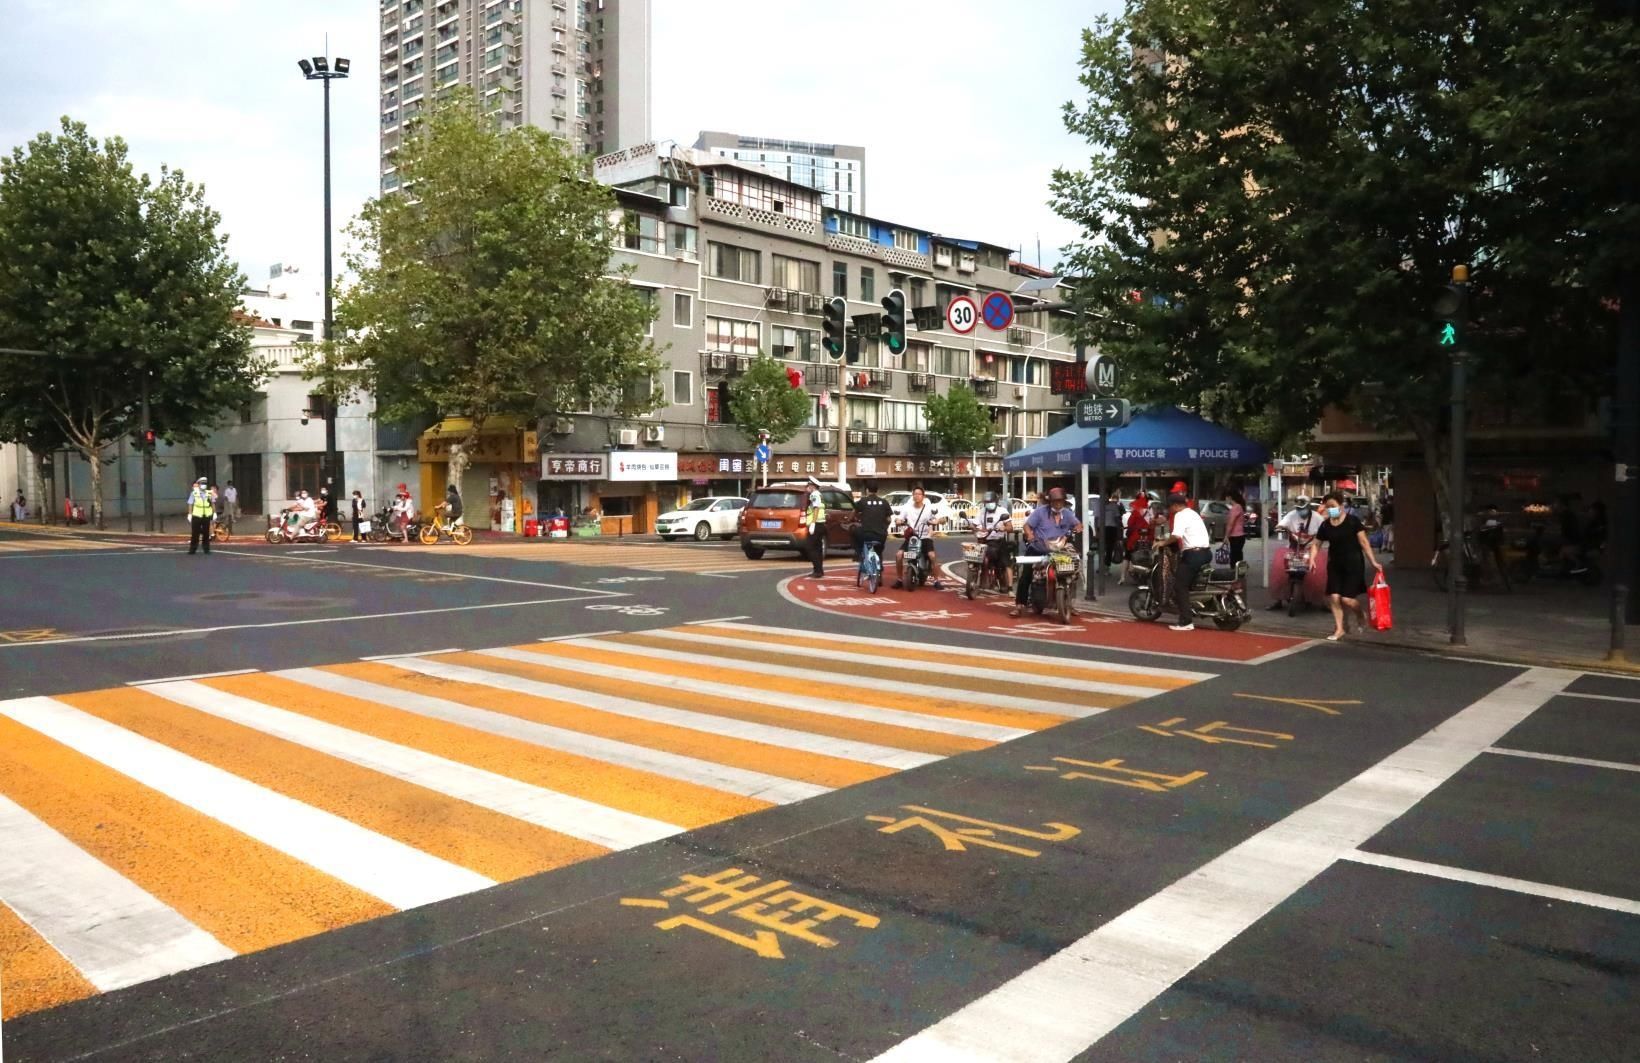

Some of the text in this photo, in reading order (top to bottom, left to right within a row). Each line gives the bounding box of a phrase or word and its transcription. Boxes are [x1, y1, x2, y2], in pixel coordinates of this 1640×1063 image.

[954, 306, 972, 325] 30
[1084, 403, 1103, 415] 地铁
[1125, 449, 1156, 458] POLICE
[1199, 449, 1229, 459] POLICE
